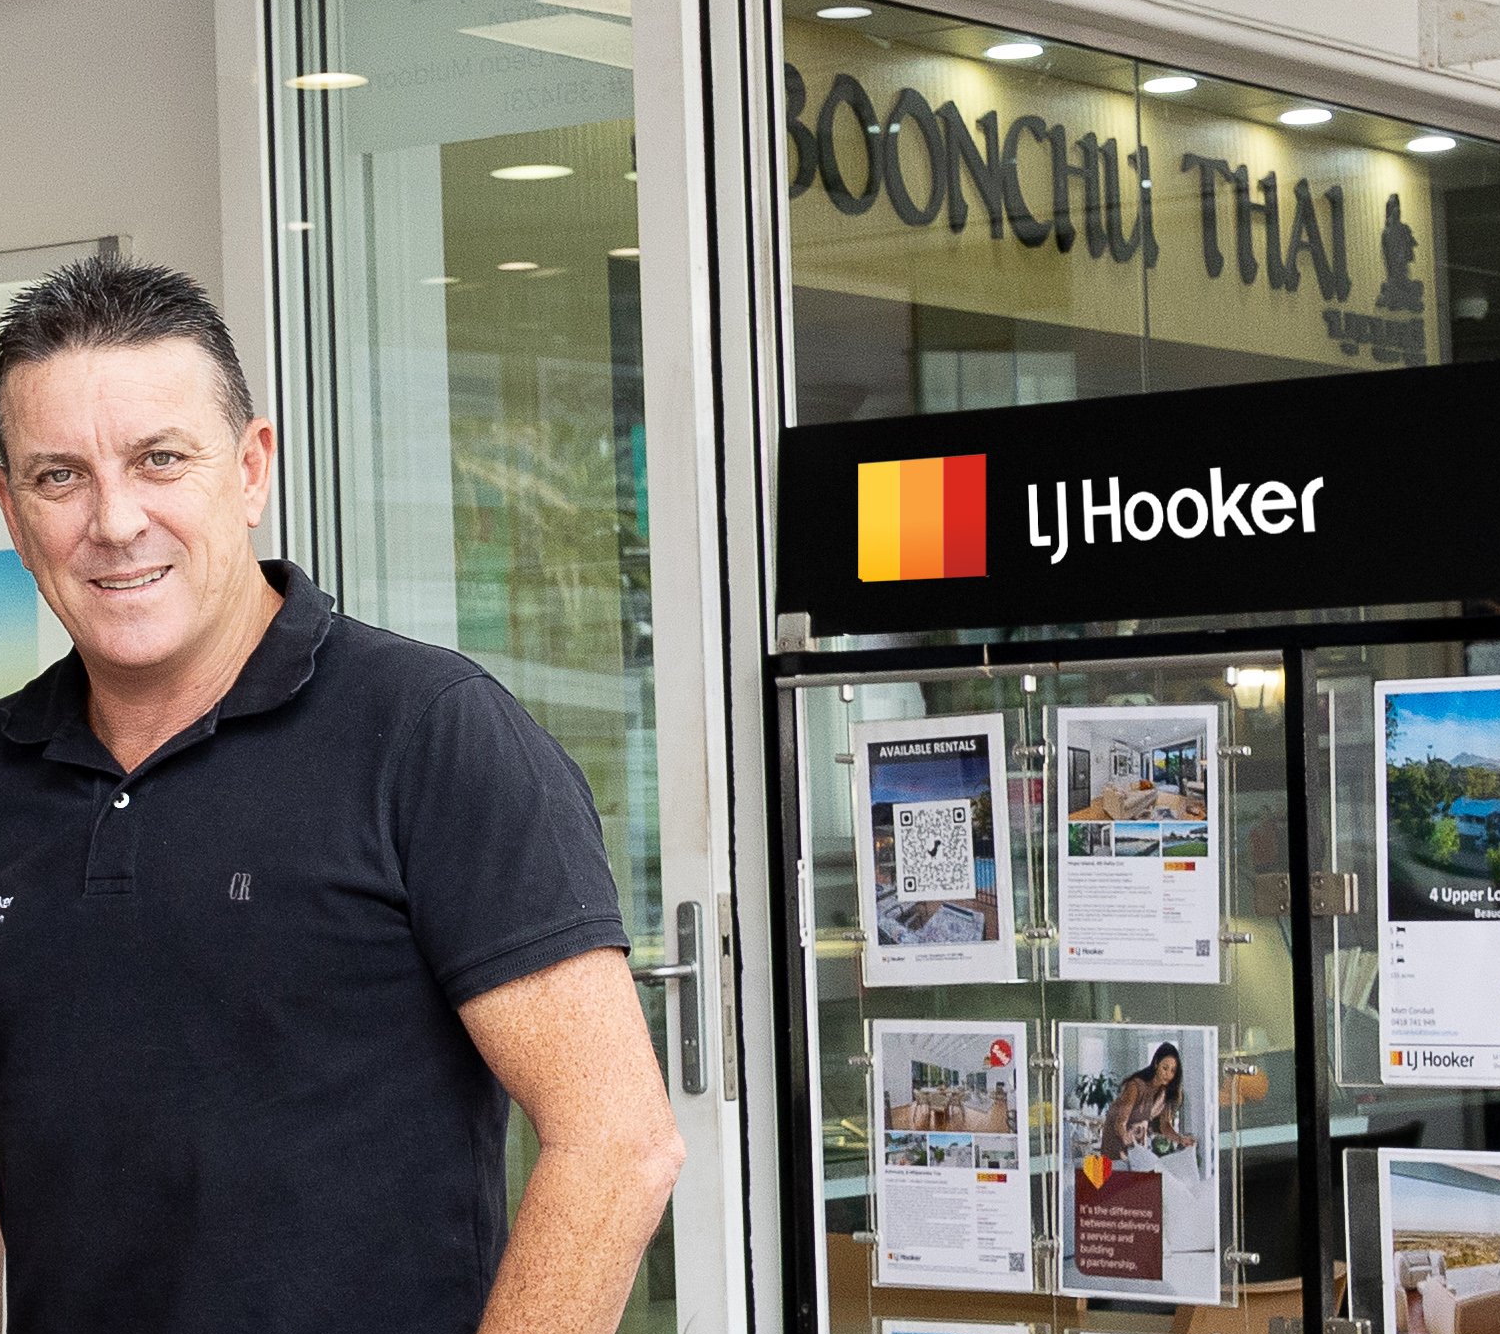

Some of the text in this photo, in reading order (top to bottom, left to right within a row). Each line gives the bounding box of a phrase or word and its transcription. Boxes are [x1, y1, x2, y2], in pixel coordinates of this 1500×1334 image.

[1181, 153, 1351, 303] THAI
[1028, 467, 1323, 564] LJ Hooker
[880, 739, 976, 758] AVAILABLE RENTALS
[1430, 887, 1439, 902] 4
[1442, 888, 1484, 905] Upper
[1406, 1051, 1418, 1071] LJ
[1423, 1051, 1474, 1067] Hooker
